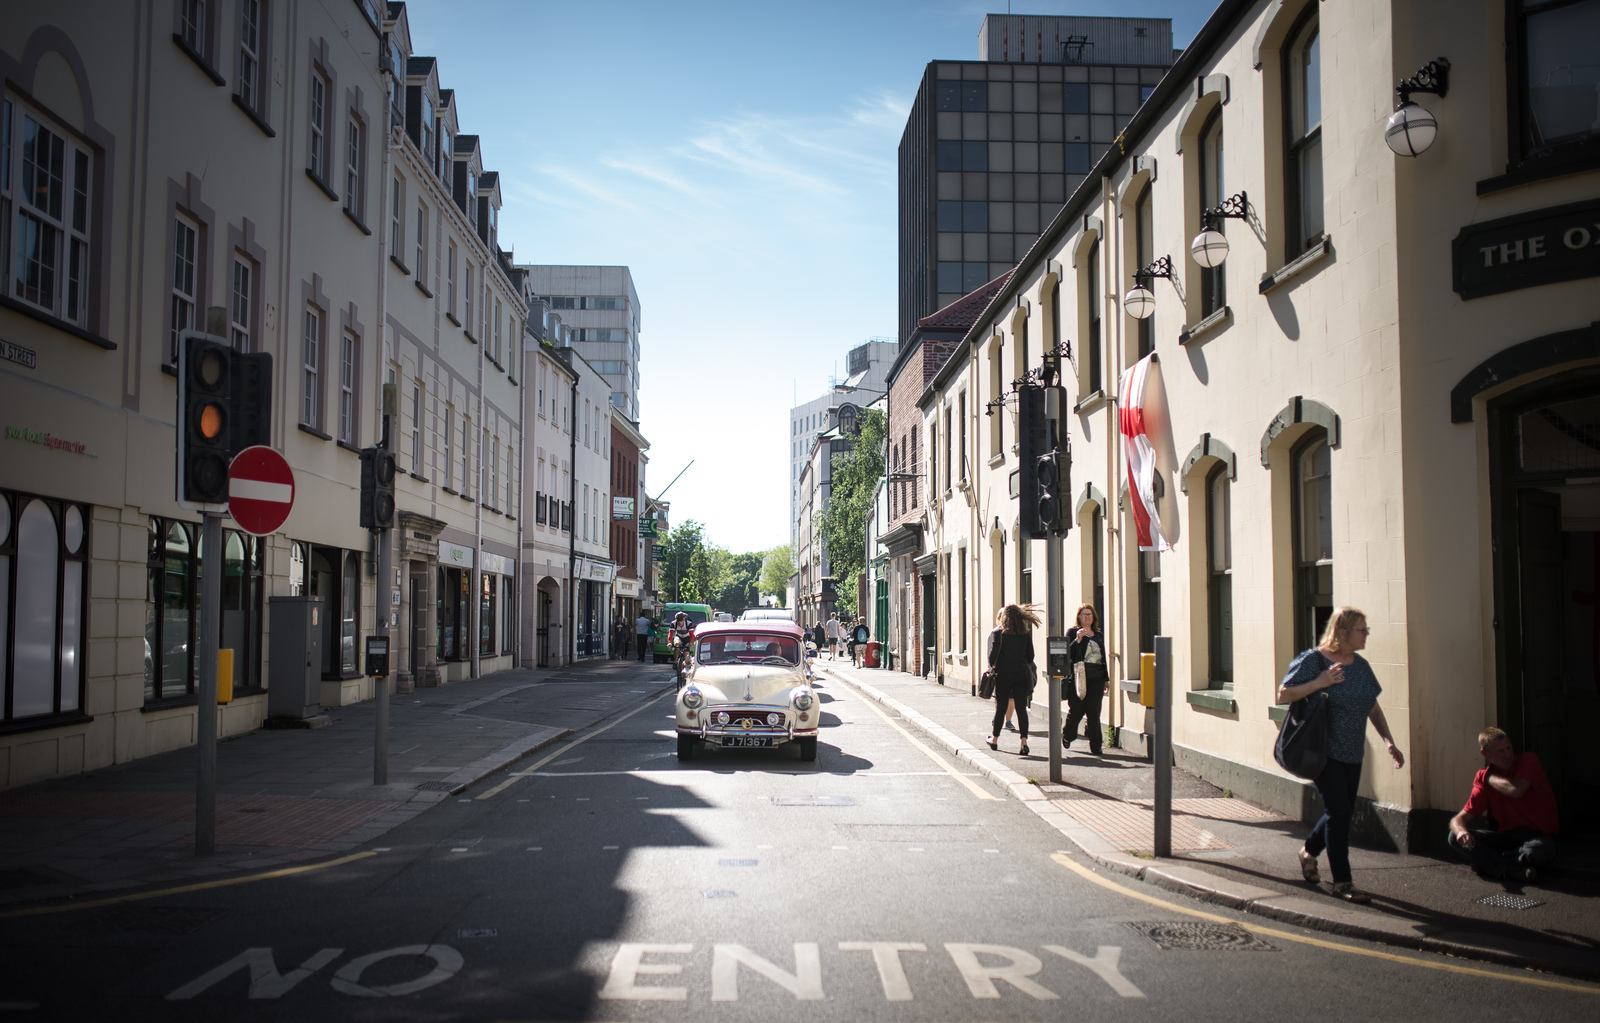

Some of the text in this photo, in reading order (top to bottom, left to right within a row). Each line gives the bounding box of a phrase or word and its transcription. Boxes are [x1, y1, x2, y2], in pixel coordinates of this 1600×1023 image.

[1479, 234, 1548, 268] THE
[8, 345, 34, 365] STREET
[728, 737, 767, 746] J 71367
[163, 939, 1147, 1002] NO ENTRY
